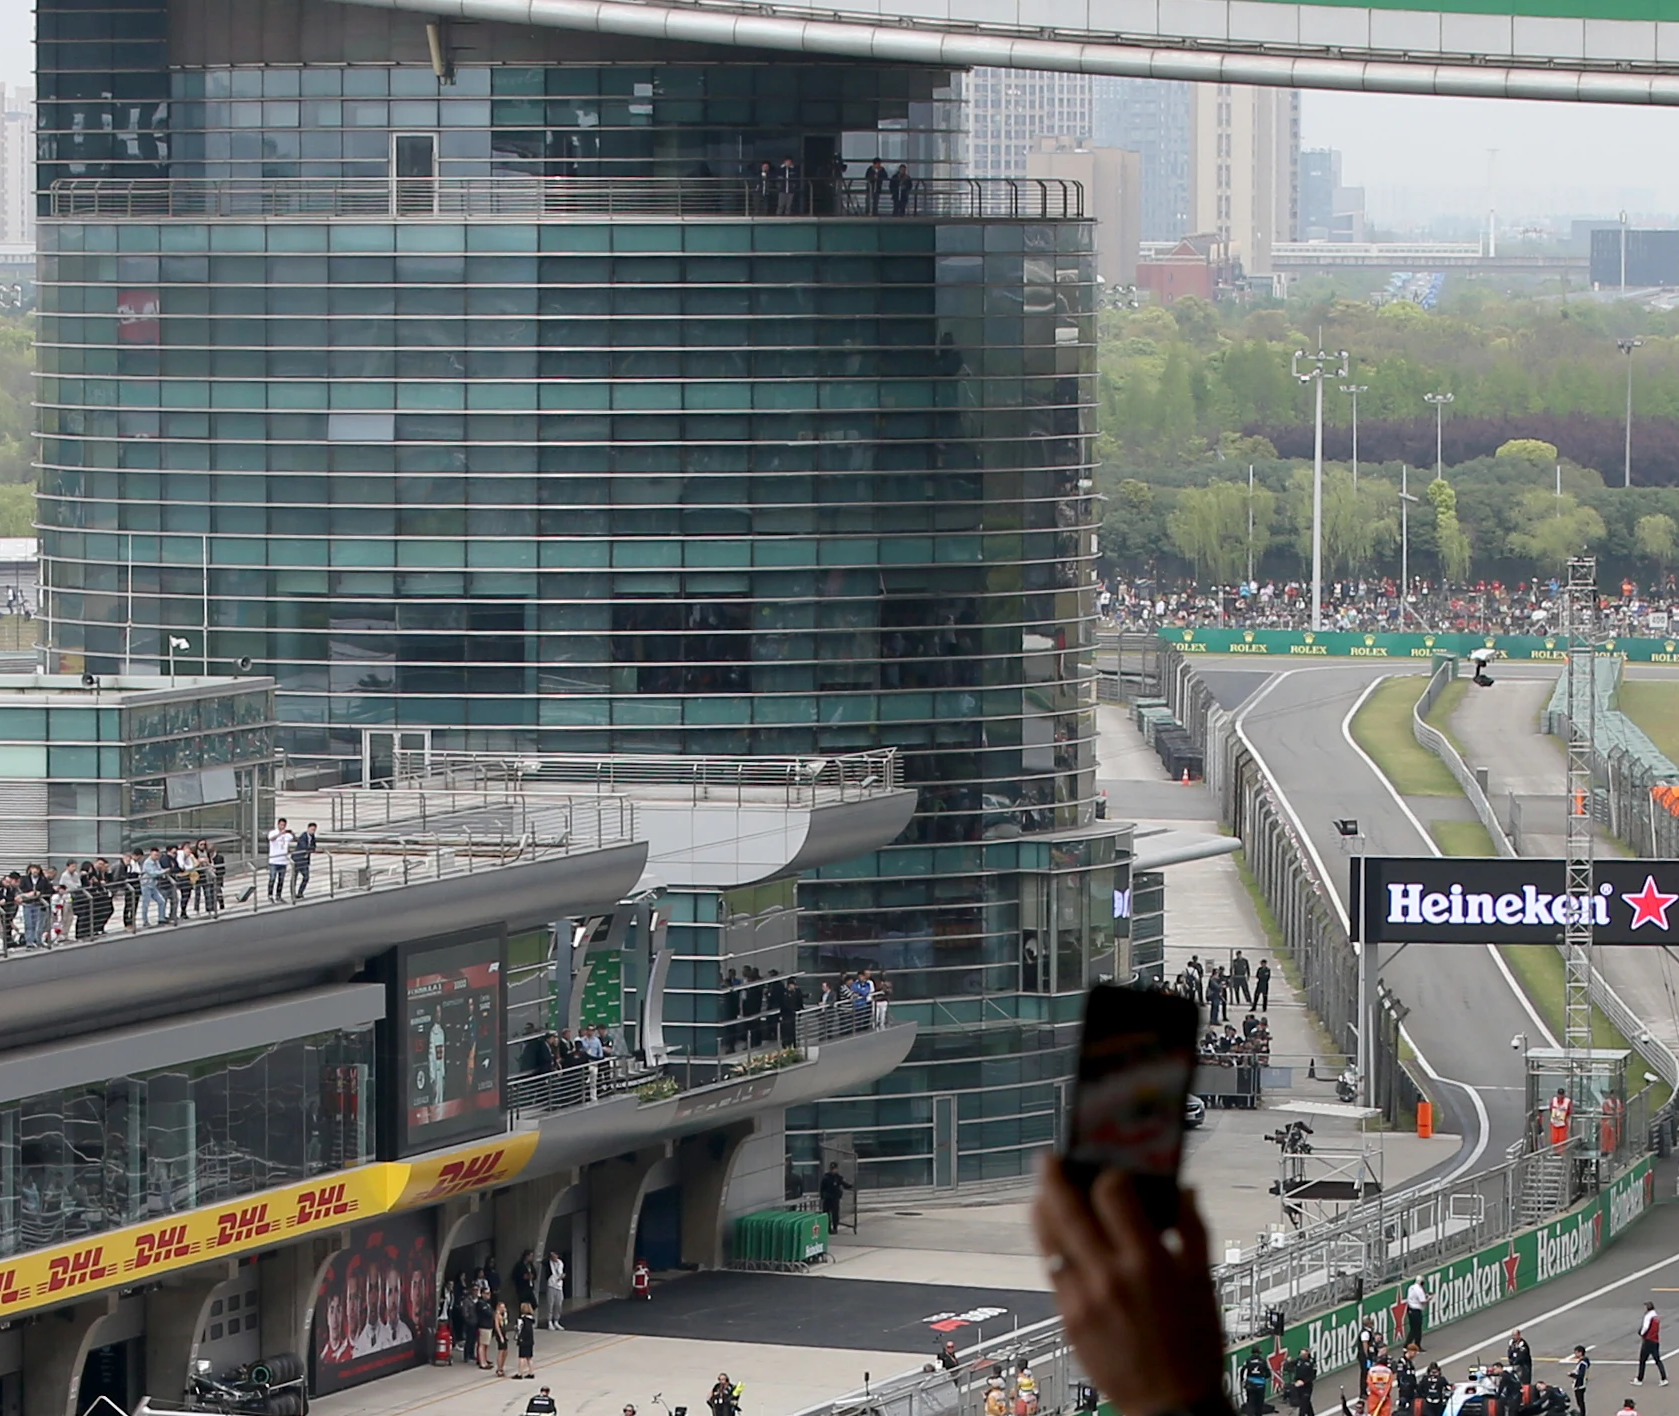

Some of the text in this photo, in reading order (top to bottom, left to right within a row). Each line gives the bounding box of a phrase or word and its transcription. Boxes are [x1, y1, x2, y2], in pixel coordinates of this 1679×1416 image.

[1229, 644, 1268, 653] ROLEX
[1290, 645, 1327, 655] ROLEX
[1350, 647, 1388, 656] ROLEX
[428, 1149, 506, 1196] DHL
[217, 1203, 273, 1246] DHL
[296, 1183, 348, 1225] DHL
[47, 1246, 109, 1291] DHL
[134, 1224, 190, 1270] DHL
[1536, 1213, 1594, 1282] Heineken
